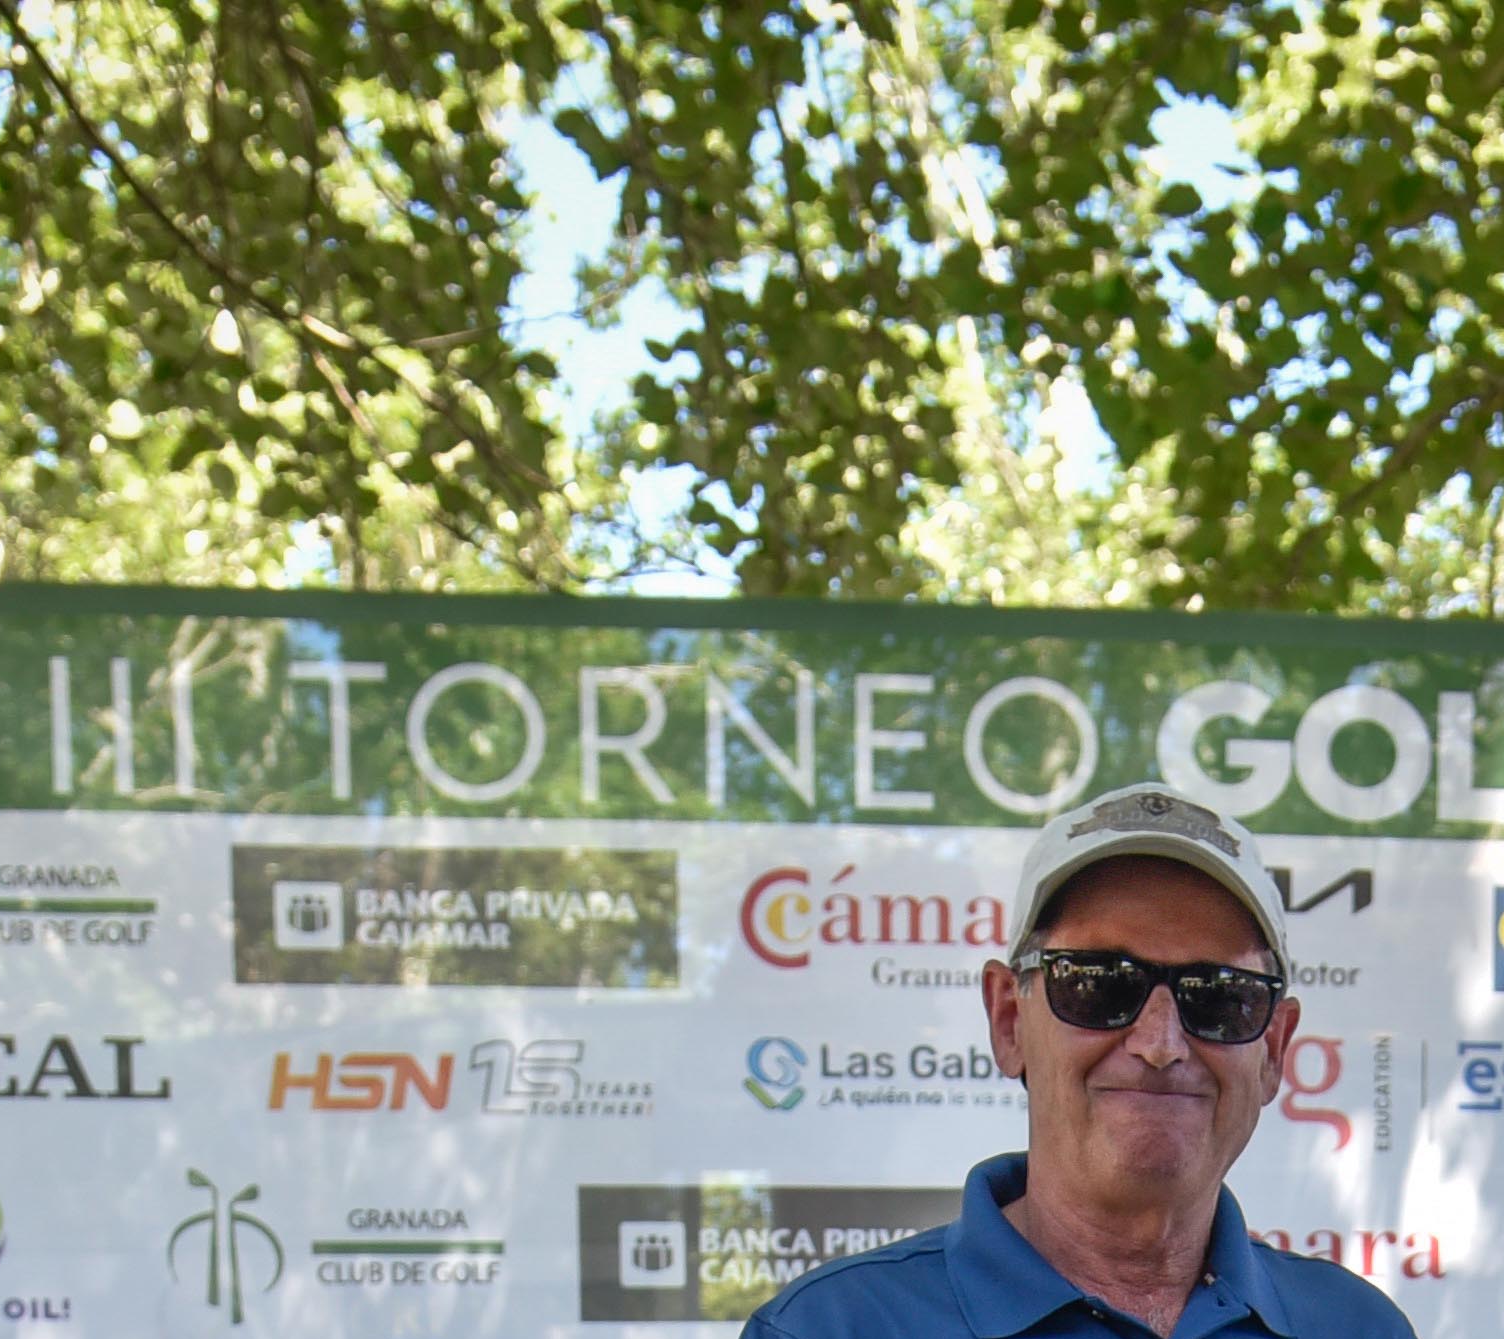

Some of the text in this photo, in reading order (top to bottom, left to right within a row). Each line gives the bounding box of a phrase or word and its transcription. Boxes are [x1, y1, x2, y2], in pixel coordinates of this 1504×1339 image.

[290, 660, 1097, 815] TORNEO
[356, 886, 639, 922] BANCA PRIVADA
[88, 919, 156, 946] GOLF
[356, 921, 511, 949] CAJAMAR
[820, 1043, 1009, 1081] Las Gab
[267, 1051, 454, 1113] HSN
[1372, 1034, 1393, 1151] EDUCATION
[347, 1207, 469, 1233] GRANADA
[698, 1226, 818, 1255] BANCA
[316, 1259, 501, 1286] CLUB DE GOLF
[698, 1258, 822, 1289] CAJAM
[2, 1298, 72, 1321] OIL!
